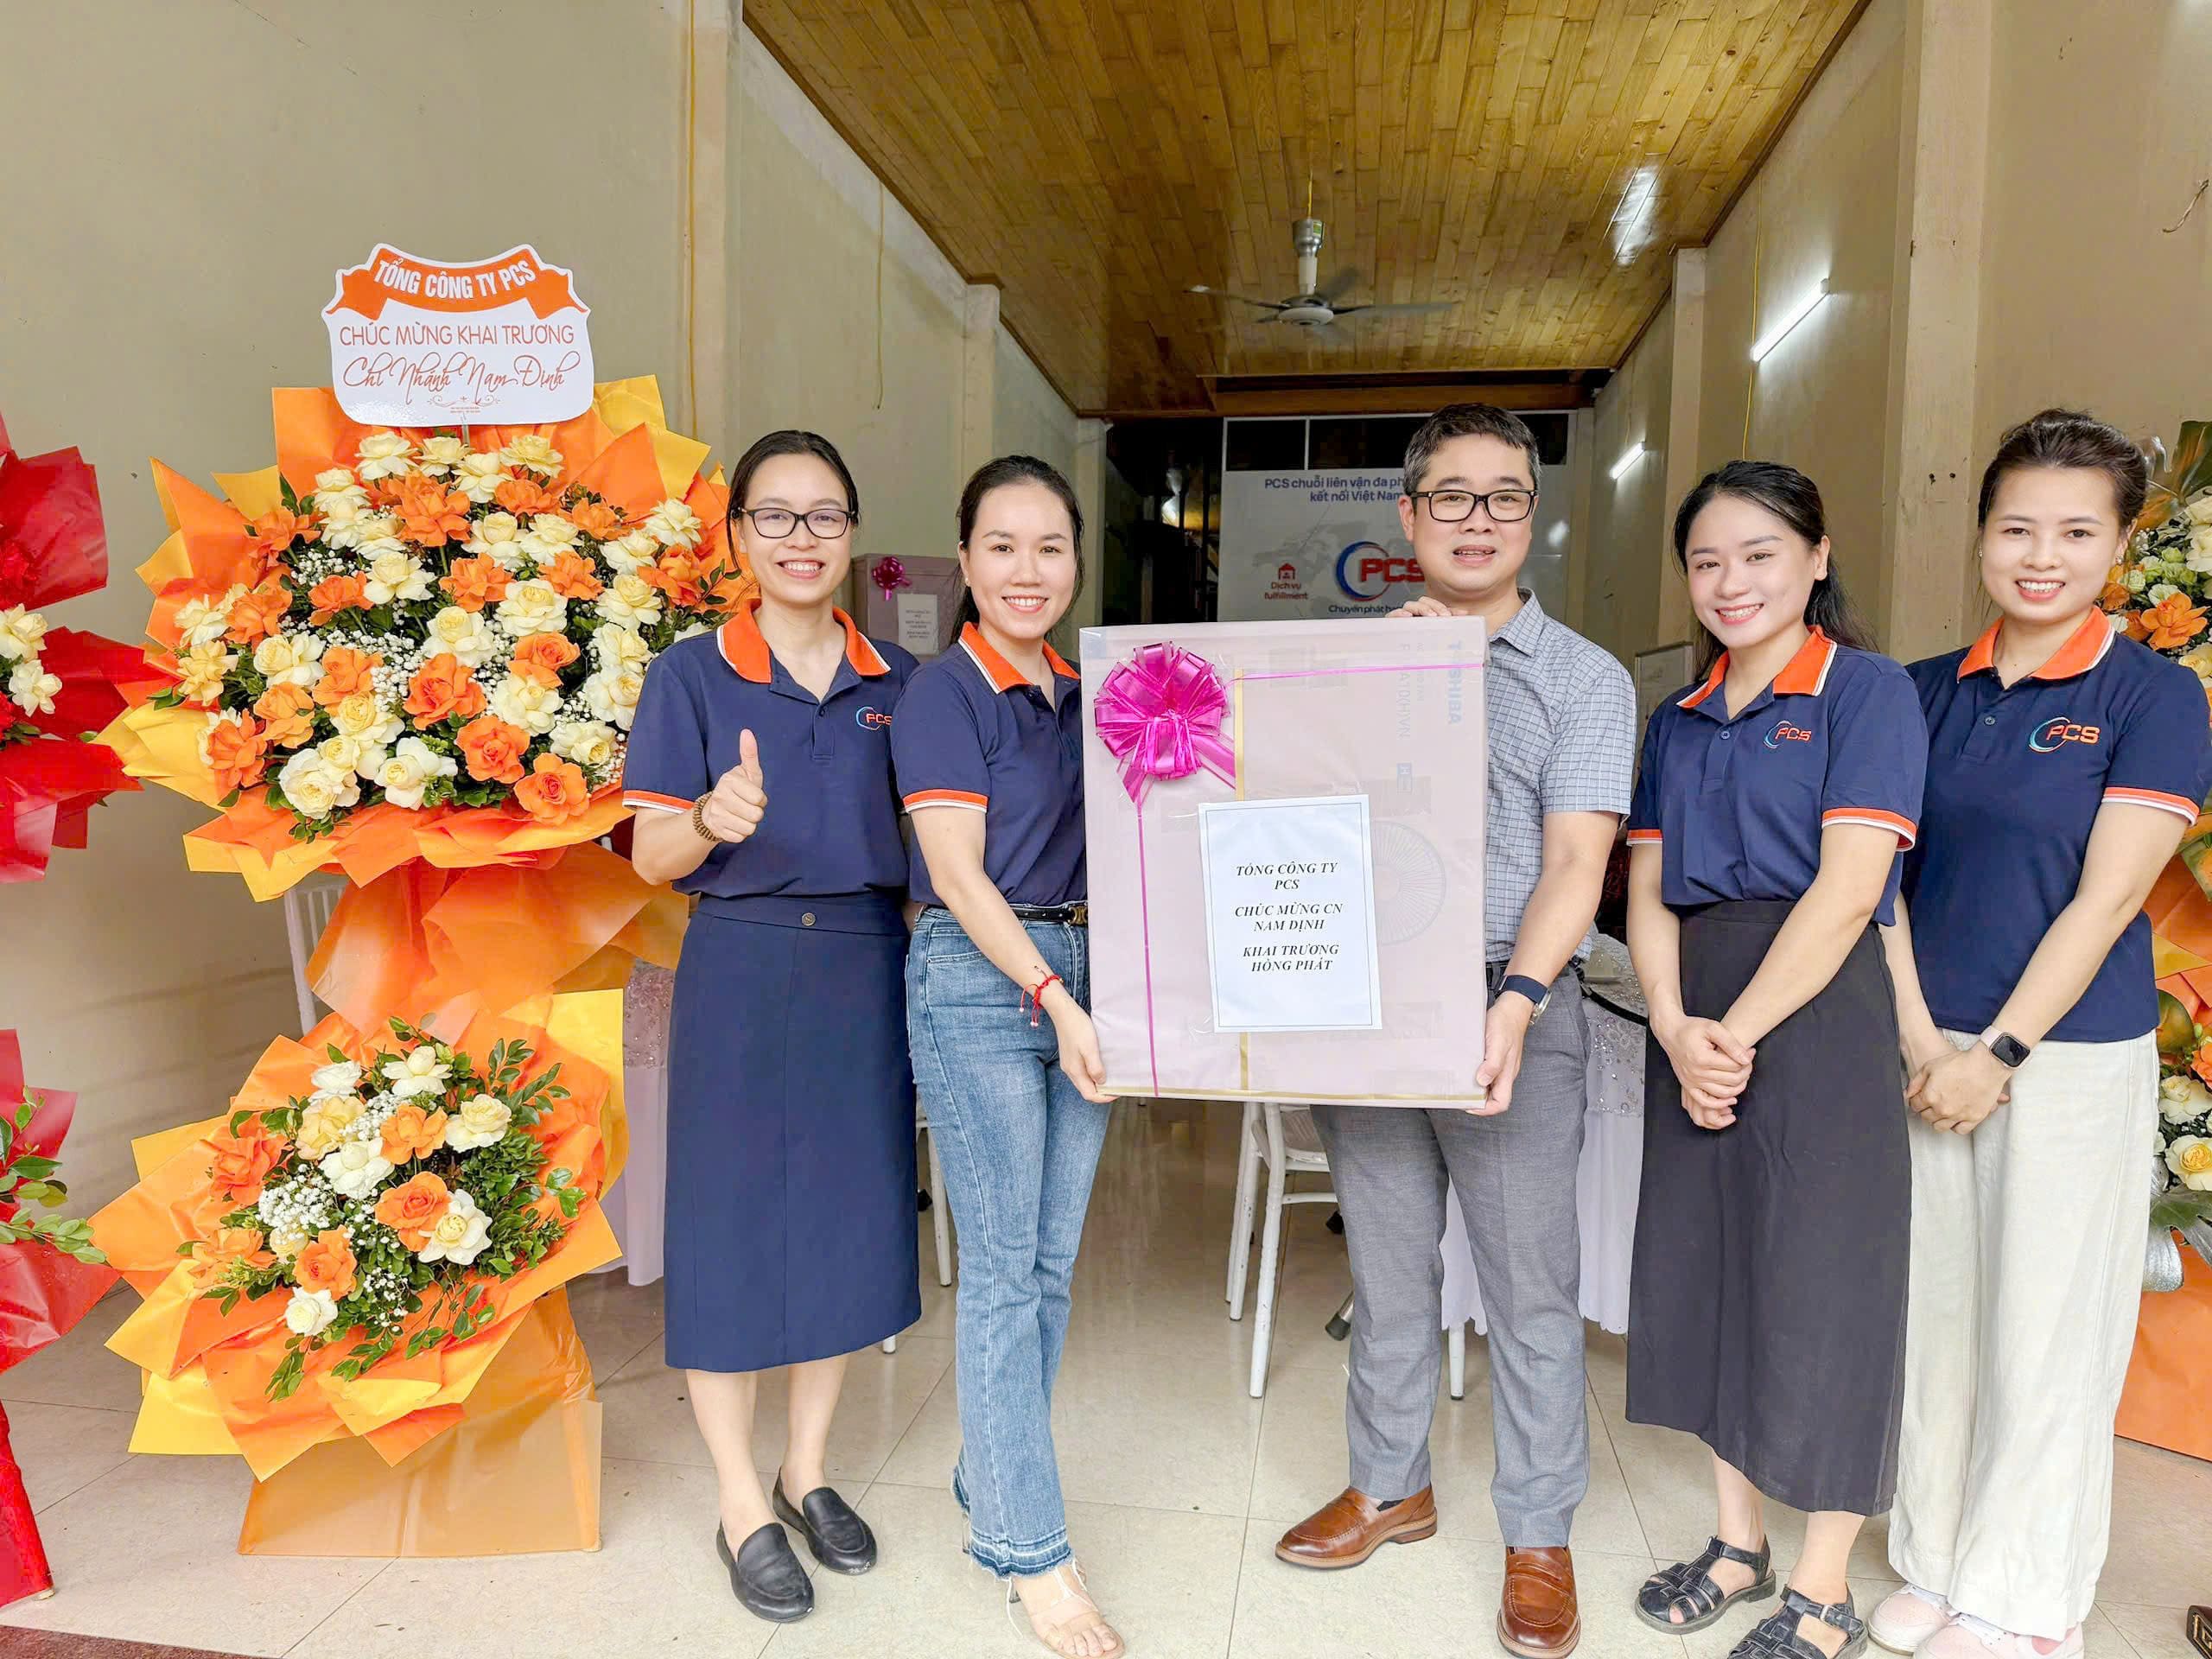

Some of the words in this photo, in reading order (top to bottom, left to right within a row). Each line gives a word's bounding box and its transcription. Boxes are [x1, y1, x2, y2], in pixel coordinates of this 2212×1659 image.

[373, 257, 421, 295] TỔNG
[424, 271, 474, 300] CÔNG
[476, 275, 497, 298] TY
[499, 259, 537, 291] PCS
[339, 322, 391, 346] CHÚC
[395, 321, 453, 346] MỪNG
[457, 325, 498, 346] KHAI
[501, 324, 575, 346] TRƯƠNG
[458, 356, 518, 404] Nam
[513, 350, 581, 391] Định
[1264, 478, 1290, 489] PCS
[1326, 476, 1348, 488] liên
[1351, 490, 1375, 504] Việt
[1359, 557, 1427, 583] PCS
[1447, 639, 1463, 725] TSHIBA
[866, 713, 893, 725] PCS
[1775, 727, 1812, 741] PCS
[2046, 724, 2101, 744] PCS
[1277, 861, 1317, 874] CÔNG
[1320, 862, 1338, 874] TY
[1274, 879, 1300, 890] PCS
[1235, 902, 1274, 917] CHÚC
[1277, 901, 1320, 916] MỪNG
[1323, 903, 1344, 914] CN
[1253, 920, 1286, 931] NAM
[1243, 945, 1278, 957] KHAI
[1295, 957, 1333, 970] PHÁT
